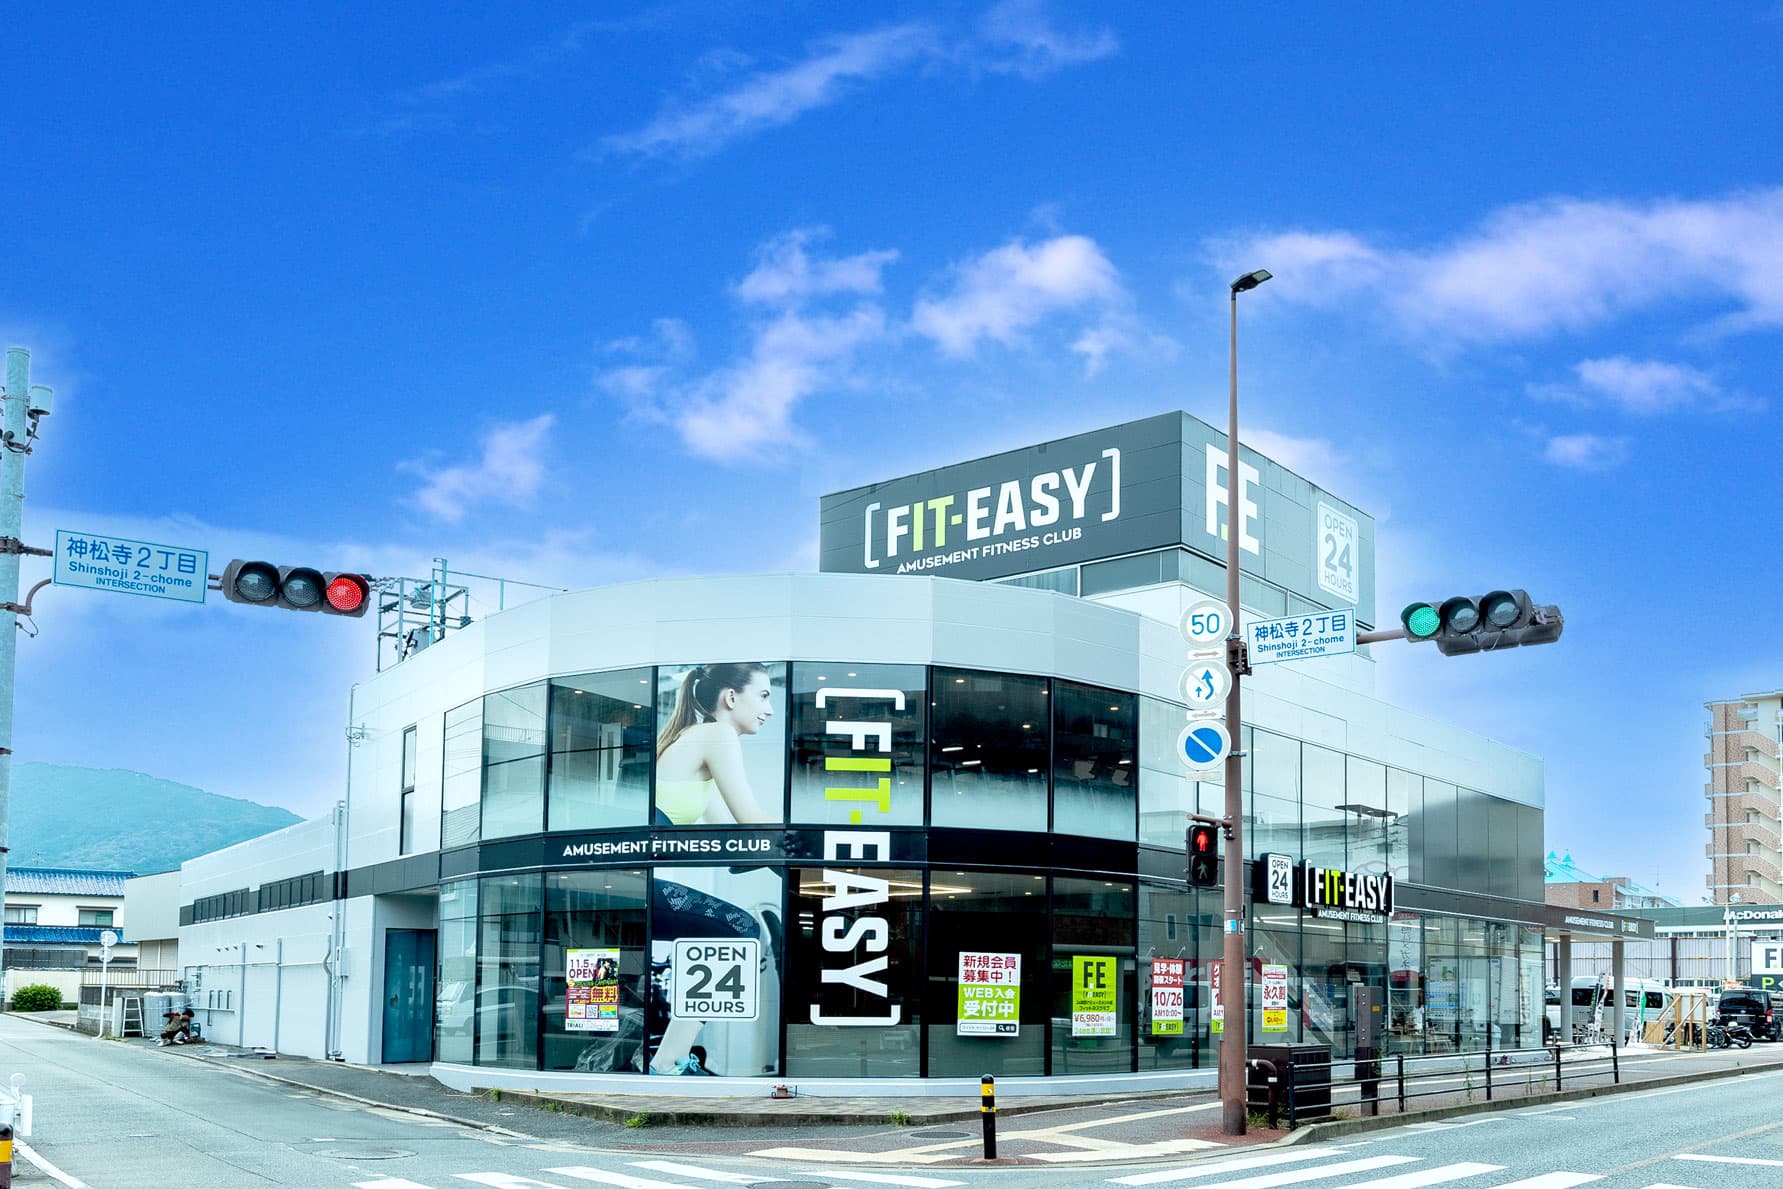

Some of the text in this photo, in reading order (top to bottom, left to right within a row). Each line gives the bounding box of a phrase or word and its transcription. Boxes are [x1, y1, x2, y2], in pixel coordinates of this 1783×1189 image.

[1324, 514, 1353, 538] OPEN
[66, 536, 197, 575] 神松寺2丁目
[896, 527, 1082, 574] AMUSEMENT FITNESS CLUB
[1324, 533, 1353, 578] 24
[69, 560, 193, 588] Shinshoji 2-chome
[1324, 569, 1353, 594] HOURS
[96, 577, 166, 595] INTERSECTION
[1191, 613, 1220, 635] 50
[1254, 614, 1346, 642] 神松寺2丁目
[1257, 634, 1344, 653] Shinshoji 2-chome
[1276, 647, 1326, 658] INTERSECTION
[562, 839, 771, 857] AMUSEMENT FITNESS CLUB
[1271, 859, 1289, 870] OPEN
[1271, 870, 1289, 891] 24
[1271, 891, 1289, 899] HOURS
[1723, 909, 1783, 920] McDonal
[686, 946, 746, 961] OPEN
[963, 955, 1017, 969] 新規会員
[569, 968, 596, 979] OPEN
[686, 964, 746, 999] 24
[1762, 977, 1775, 990] P
[685, 1001, 745, 1013] HOURS
[1153, 991, 1183, 1007] 10/26
[963, 1000, 1015, 1018] 受付中
